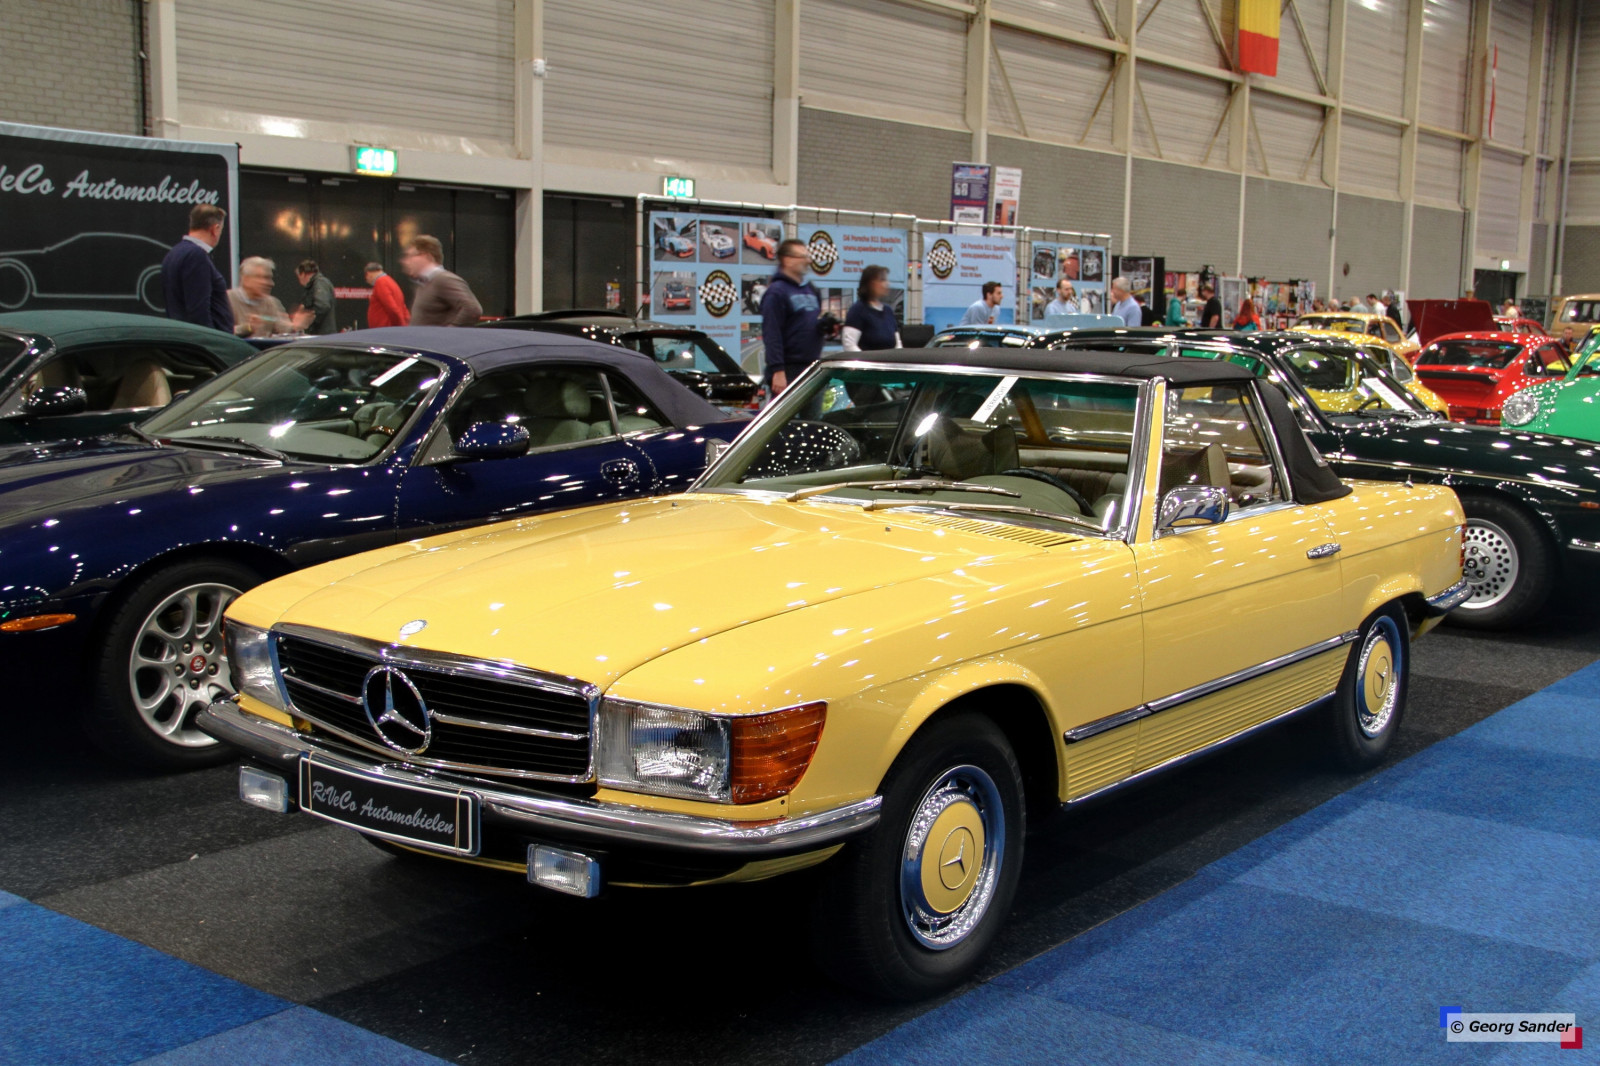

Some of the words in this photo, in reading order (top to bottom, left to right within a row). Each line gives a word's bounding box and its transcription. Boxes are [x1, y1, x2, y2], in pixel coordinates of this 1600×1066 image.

[62, 169, 220, 205] Automobielen
[851, 234, 870, 242] Porsche
[985, 385, 1008, 411] VERKOCHT
[312, 780, 358, 812] RiVeCo
[360, 797, 455, 835] Automobielen
